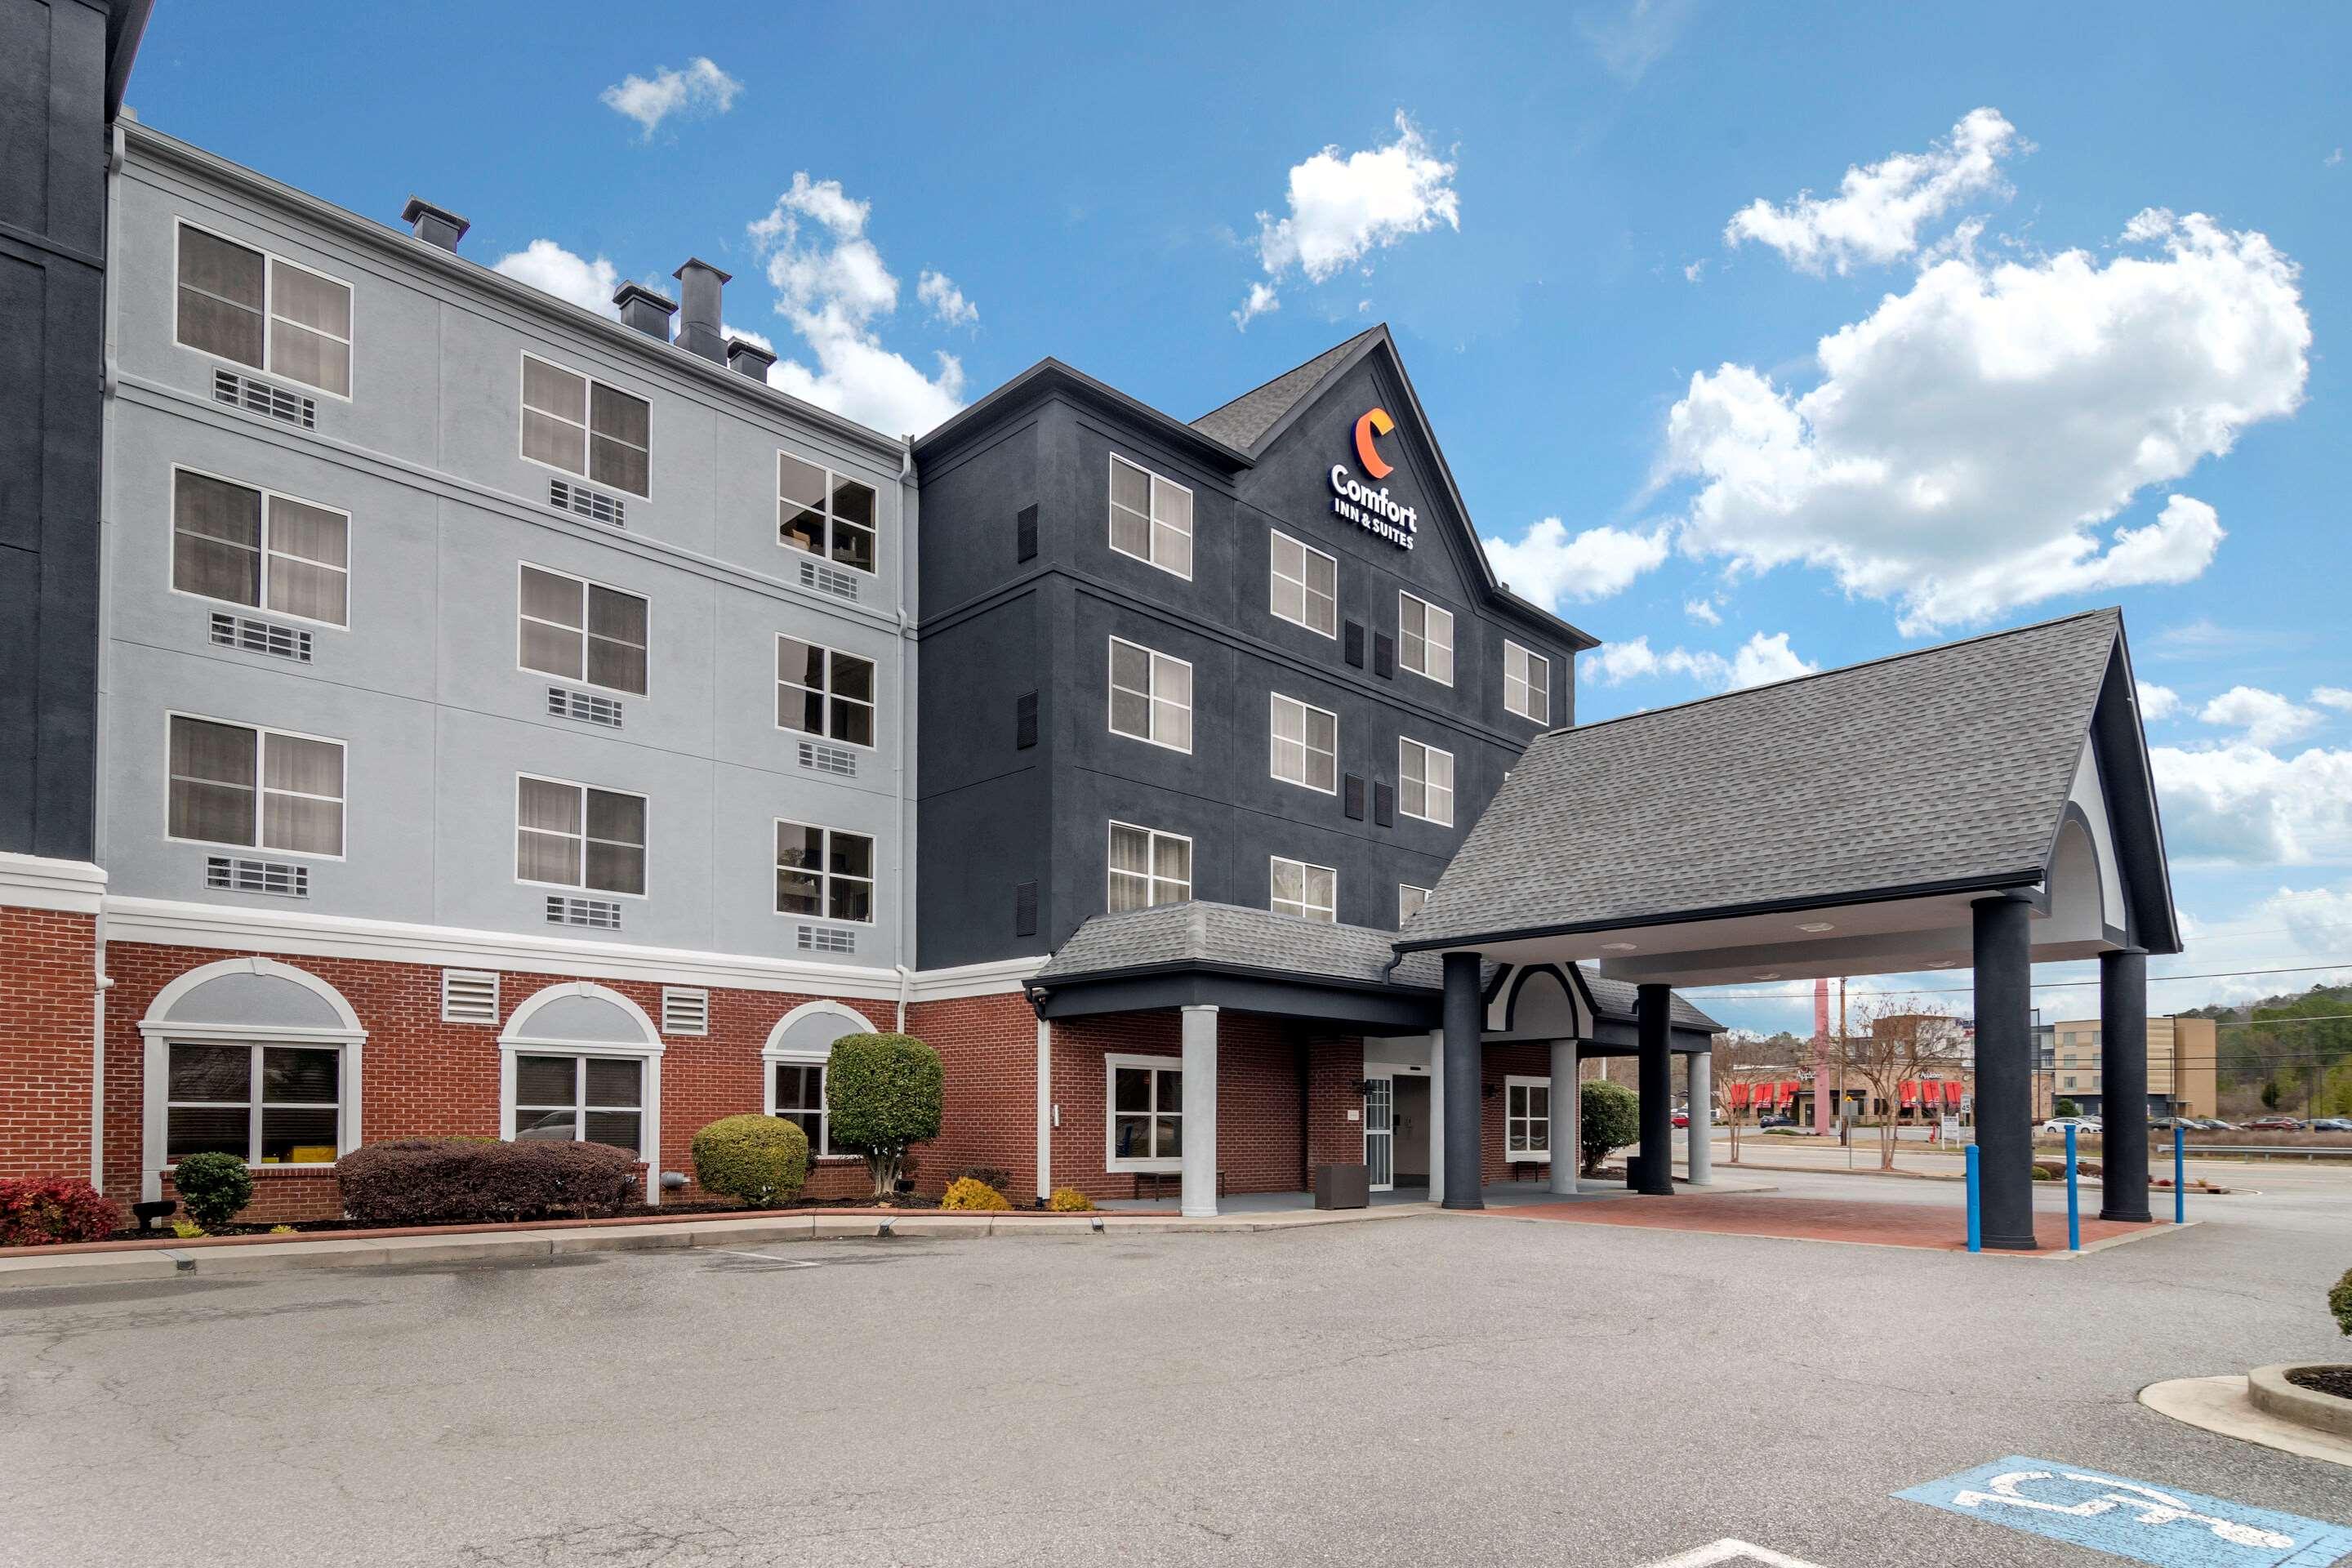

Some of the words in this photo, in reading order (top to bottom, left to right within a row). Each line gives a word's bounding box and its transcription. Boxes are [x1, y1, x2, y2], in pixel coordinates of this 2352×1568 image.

[1331, 464, 1418, 533] Comfort
[1334, 497, 1360, 523] INN
[1361, 513, 1371, 529] &
[1372, 518, 1414, 550] SUITES
